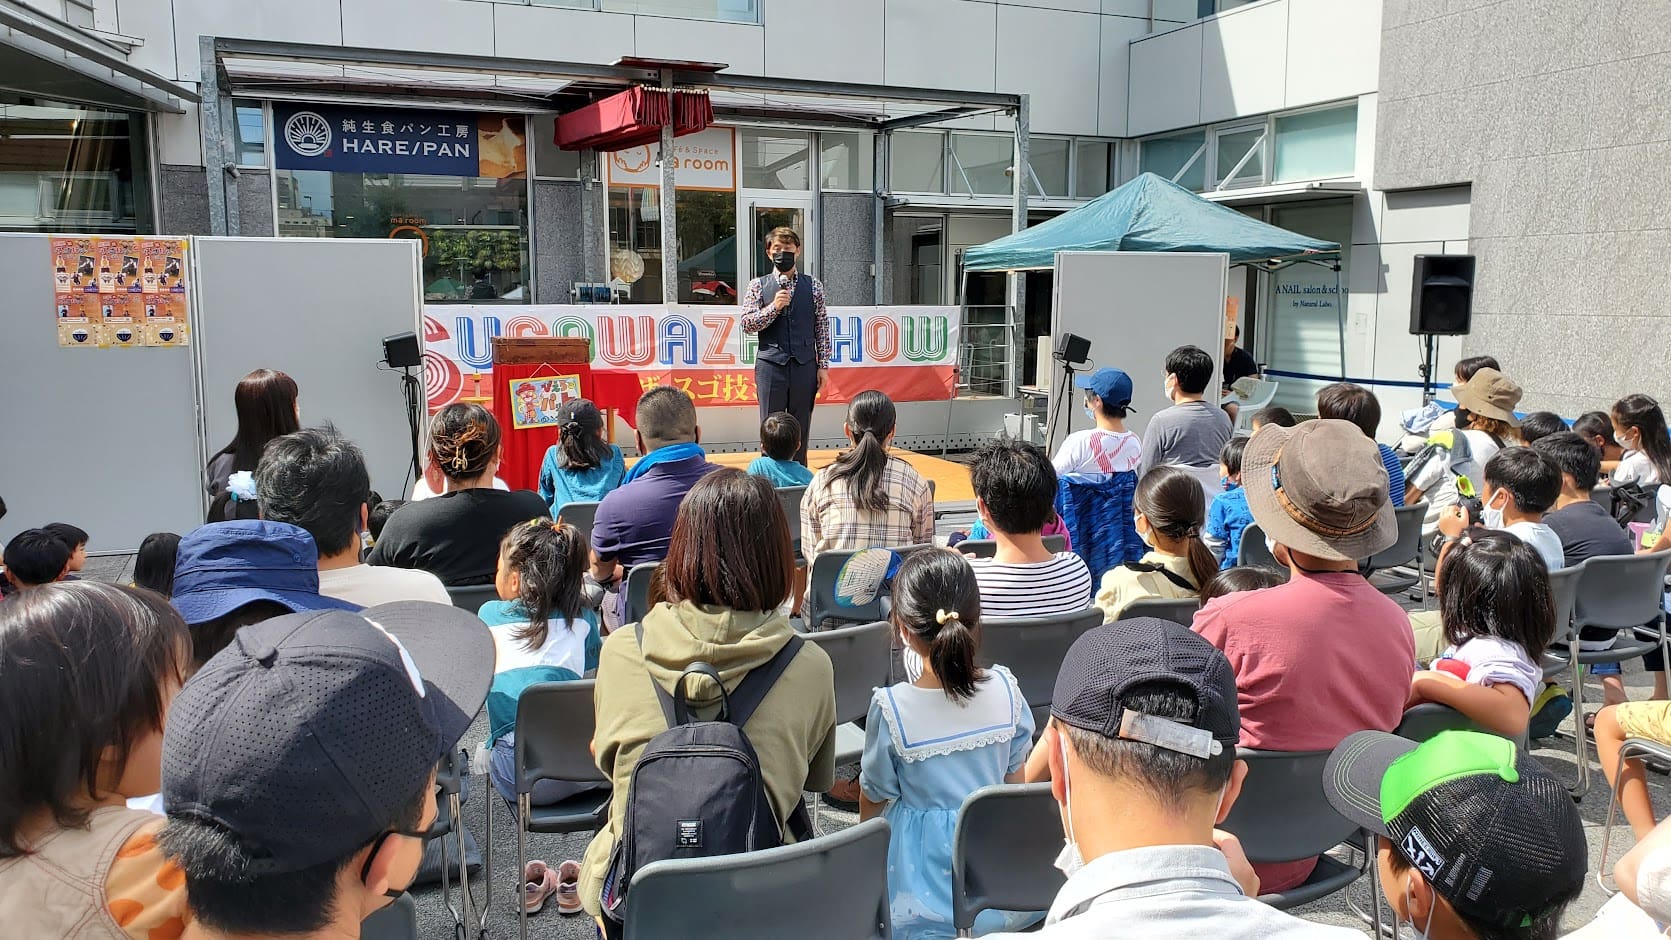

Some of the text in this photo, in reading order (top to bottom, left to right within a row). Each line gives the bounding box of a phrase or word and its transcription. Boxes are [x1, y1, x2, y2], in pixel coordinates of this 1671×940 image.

[342, 118, 469, 139] 純生食パン工房
[342, 138, 470, 158] HARE/PAN
[684, 158, 728, 171] room
[404, 217, 427, 225] room
[1275, 284, 1281, 294] A
[1282, 284, 1300, 294] NAIL
[1303, 284, 1321, 294] salon
[1321, 284, 1328, 294] &
